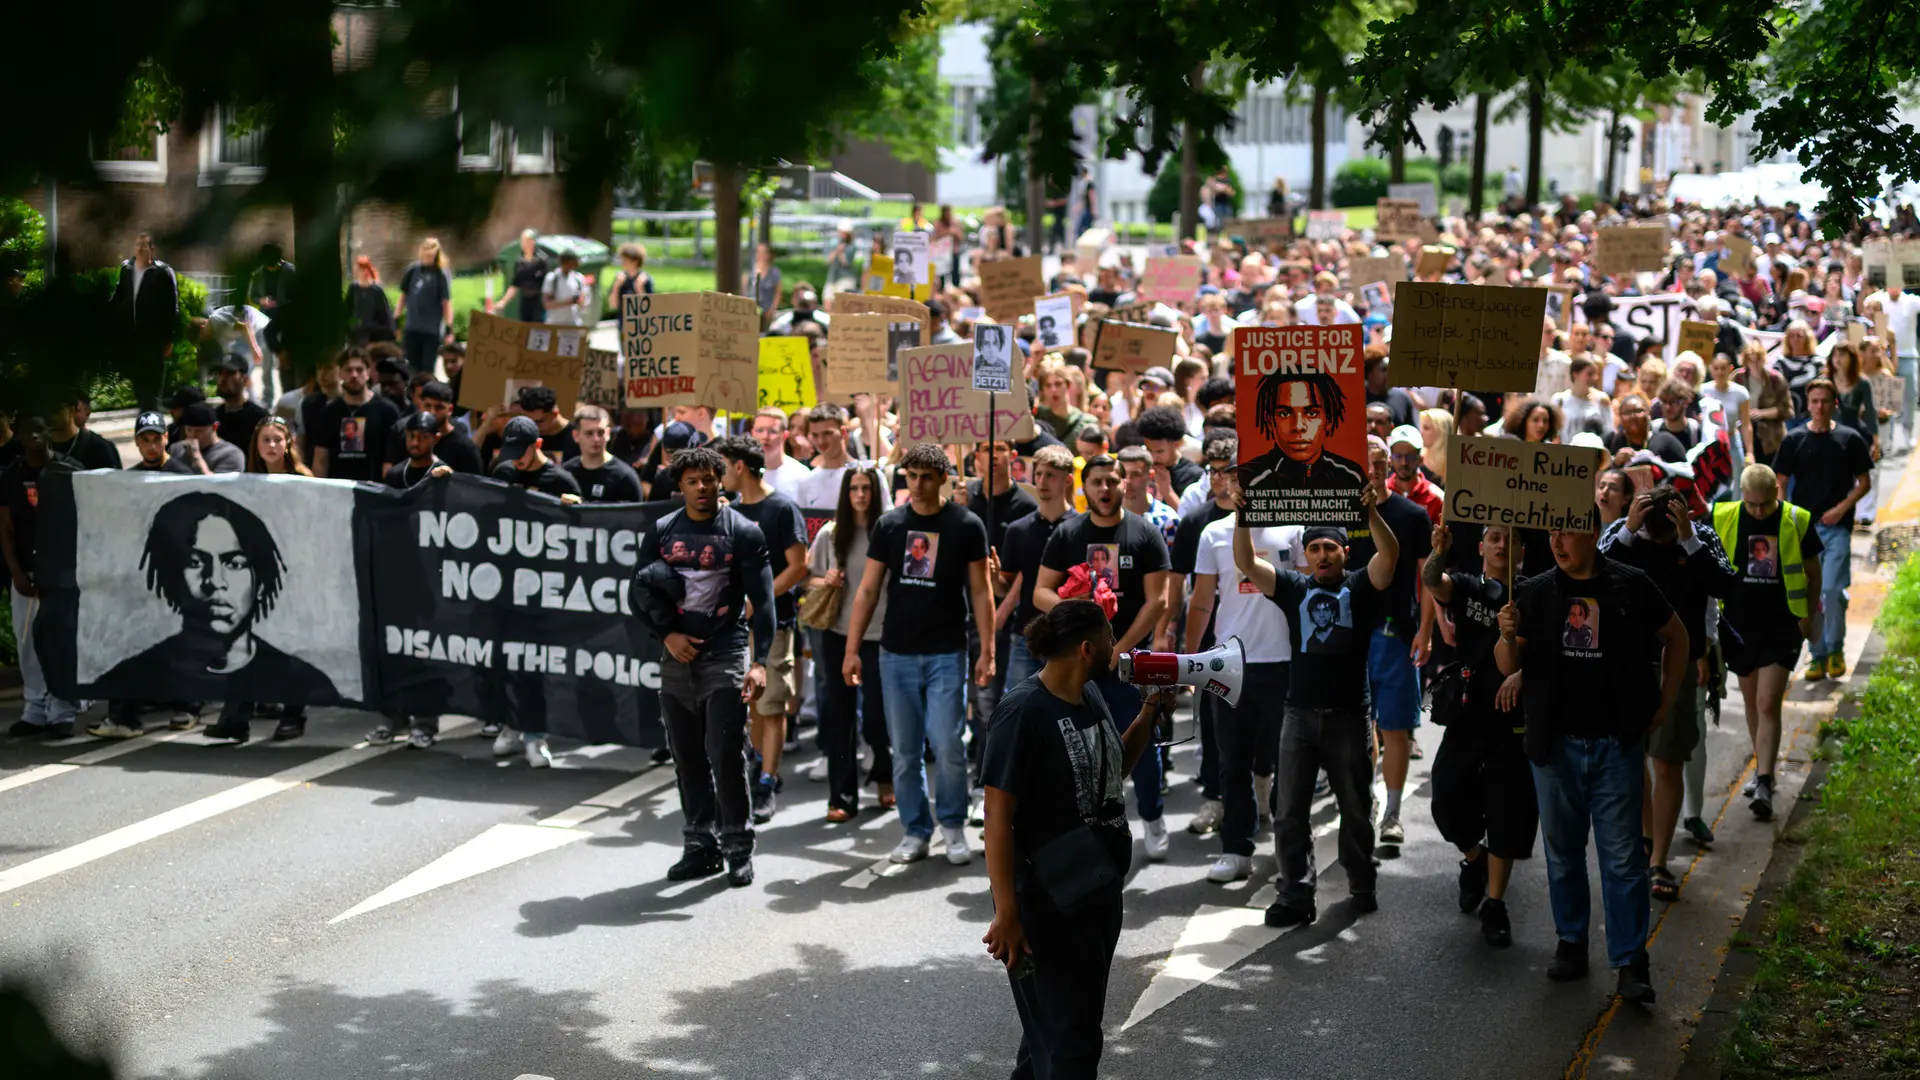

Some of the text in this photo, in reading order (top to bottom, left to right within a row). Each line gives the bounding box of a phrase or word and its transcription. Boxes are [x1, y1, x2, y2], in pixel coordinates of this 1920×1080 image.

[627, 295, 651, 317] NO
[1412, 289, 1533, 318] Dienstwaffe
[627, 314, 693, 338] JUSTICE
[628, 337, 652, 358] NO
[1241, 329, 1353, 348] JUSTICE FOR
[629, 356, 680, 377] PEACE
[908, 353, 973, 386] AGAIN
[1242, 347, 1357, 376] LORENZ
[1460, 443, 1589, 480] Keine Ruhe
[1245, 487, 1362, 498] ER HATTE TRÄUME, KEINE WAFFE.
[1506, 473, 1548, 494] ohne
[1245, 511, 1362, 522] KEINE MENSCHLICHKEIT.
[1251, 499, 1352, 511] SIE HATTEN MACHT,
[1452, 488, 1594, 532] Gerechtigkeit
[418, 510, 646, 567] NO JUSTIC
[442, 559, 502, 601] NO
[385, 625, 662, 690] DISARM THE POLIC
